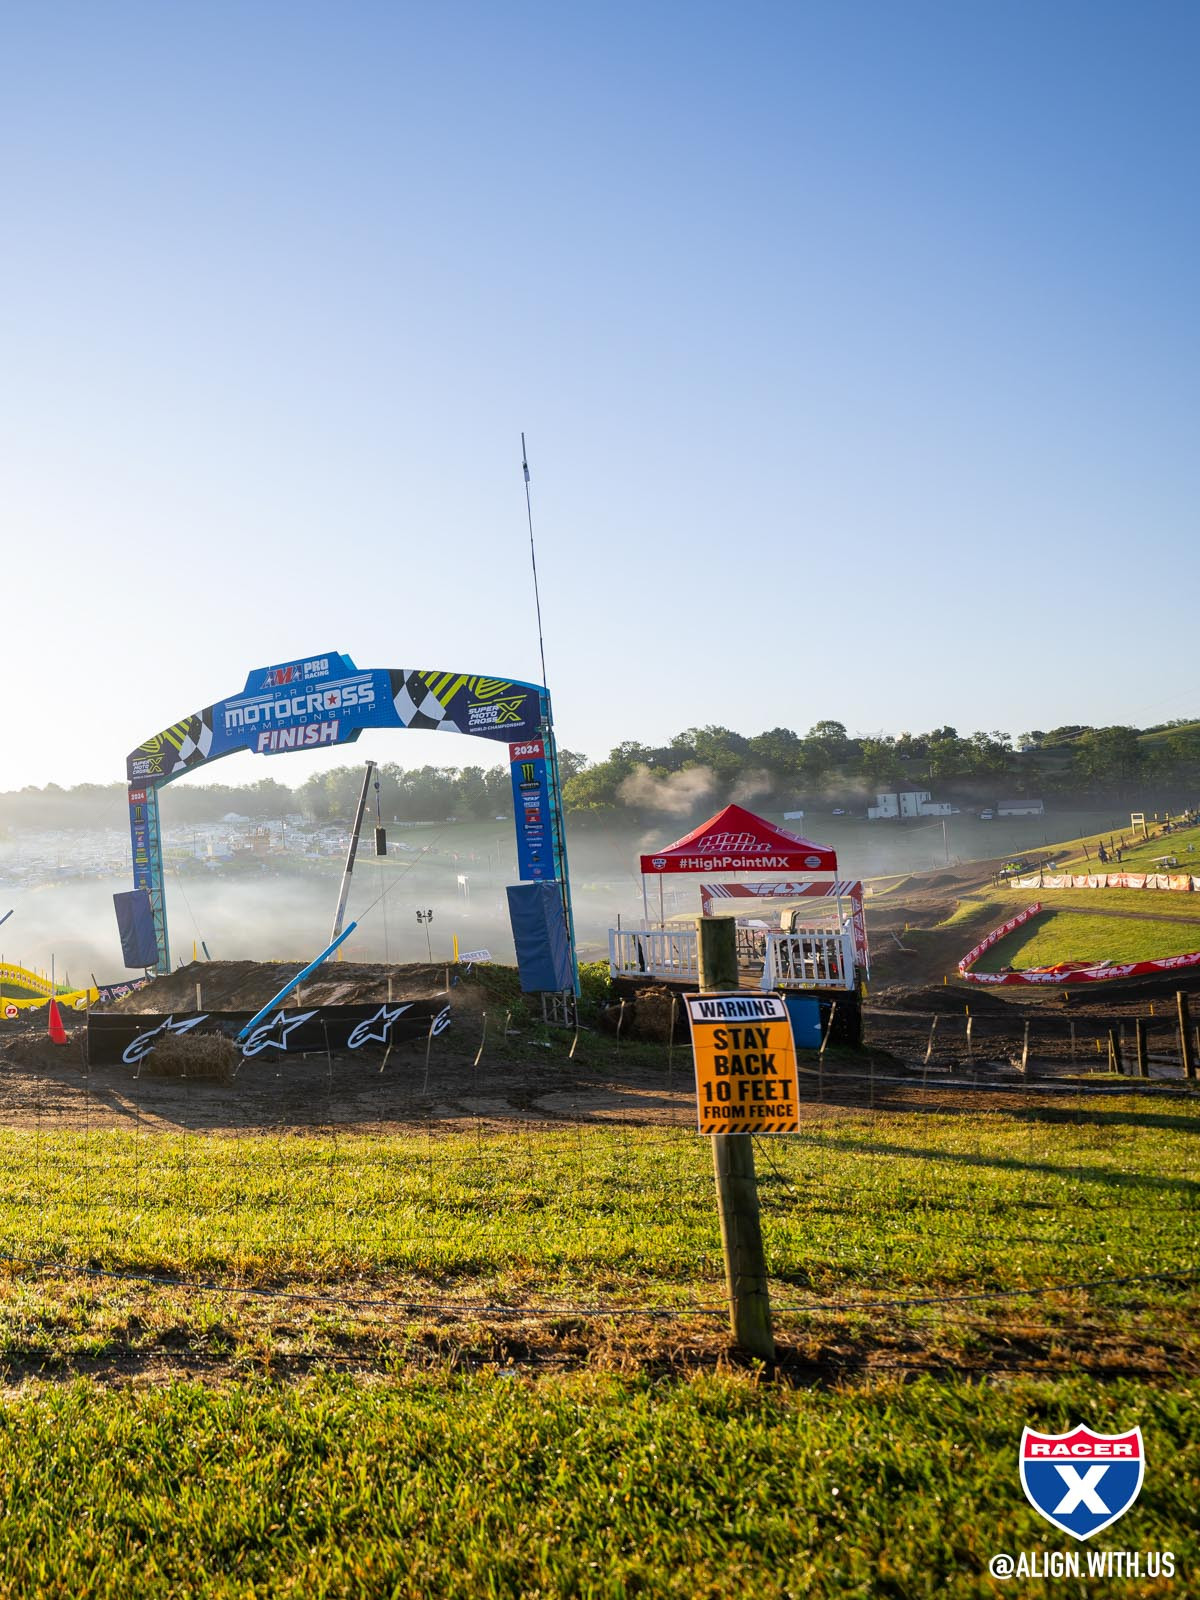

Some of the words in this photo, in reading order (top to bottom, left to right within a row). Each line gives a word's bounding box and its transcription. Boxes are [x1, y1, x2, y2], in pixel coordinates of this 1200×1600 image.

[304, 658, 329, 673] PRO
[304, 670, 329, 680] RACING
[275, 685, 313, 698] PRO
[225, 682, 375, 728] MOTOCROSS
[468, 705, 499, 714] SUPER
[226, 703, 376, 736] CHAMPIONSHIP
[468, 717, 498, 726] CROSS
[470, 711, 498, 720] MOTO
[488, 722, 526, 731] CHAMPIONSHIP
[257, 719, 340, 752] FINISH
[514, 744, 540, 755] 2024
[679, 856, 790, 871] #HighPointMX
[699, 1000, 776, 1018] WARNING
[713, 1027, 770, 1051] STAY
[714, 1053, 778, 1076] BACK
[703, 1080, 731, 1102] 10
[737, 1079, 792, 1101] FEET
[704, 1105, 745, 1119] FROM
[749, 1104, 794, 1118] FENCE
